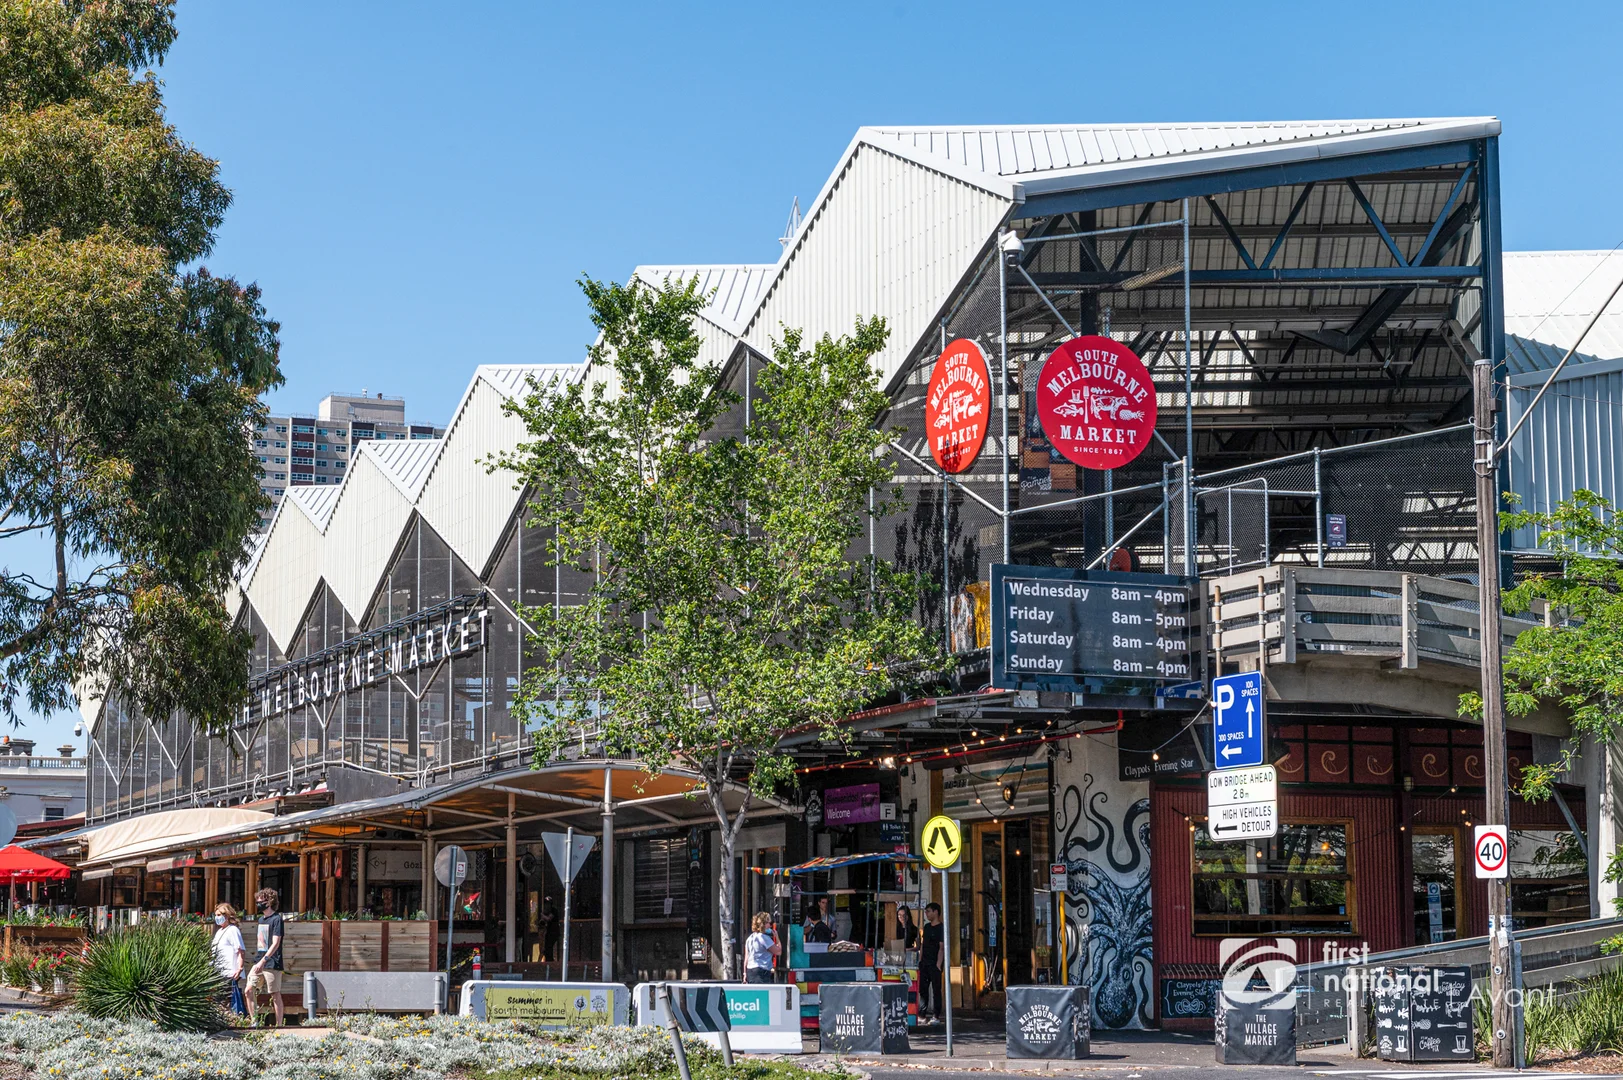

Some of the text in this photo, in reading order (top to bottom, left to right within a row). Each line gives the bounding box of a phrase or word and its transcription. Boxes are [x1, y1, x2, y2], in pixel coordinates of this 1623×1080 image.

[944, 352, 969, 372] SOUTH
[1075, 349, 1119, 366] SOUTH
[930, 365, 985, 412] MELBOURNE
[1046, 362, 1149, 404] MELBOURNE
[936, 423, 979, 451] MARKET
[1059, 424, 1137, 444] MARKET
[1009, 582, 1090, 601] Wednesday
[1111, 587, 1141, 601] 8am
[1154, 589, 1185, 605] 4pm
[378, 604, 405, 615] BRNG
[1010, 606, 1055, 624] Friday
[1112, 611, 1142, 625] 8am
[1155, 613, 1186, 629] 5pm
[1010, 630, 1074, 648] Saturday
[1112, 635, 1142, 649] 8am
[1156, 637, 1187, 653] 4pm
[262, 650, 375, 718] MELBOURNE
[391, 610, 489, 674] MARKET
[1010, 654, 1063, 672] Sunday
[1113, 659, 1143, 672] 8am
[1156, 660, 1187, 677] 4pm
[1245, 680, 1254, 689] 100
[1217, 684, 1259, 726] P SPACES
[1227, 731, 1244, 741] SPACES
[1124, 758, 1194, 778] Claypots Evening Star
[1209, 771, 1273, 789] LOW BRIDGE AHEAD
[826, 807, 851, 819] Welcome
[885, 808, 891, 818] F
[1222, 805, 1272, 820] HIGH VEHICLES
[1241, 820, 1271, 833] DETOUR
[1480, 842, 1503, 862] 40
[507, 996, 553, 1005] Summer in
[494, 1006, 566, 1015] south melbourne
[845, 1005, 855, 1014] THE
[835, 1014, 864, 1025] VILLAGE
[1018, 1010, 1062, 1026] MELBOURNE
[1255, 1014, 1267, 1023] THE
[835, 1025, 865, 1036] MARKET
[1245, 1023, 1277, 1034] VILLAGE
[1244, 1034, 1278, 1046] MARKET
